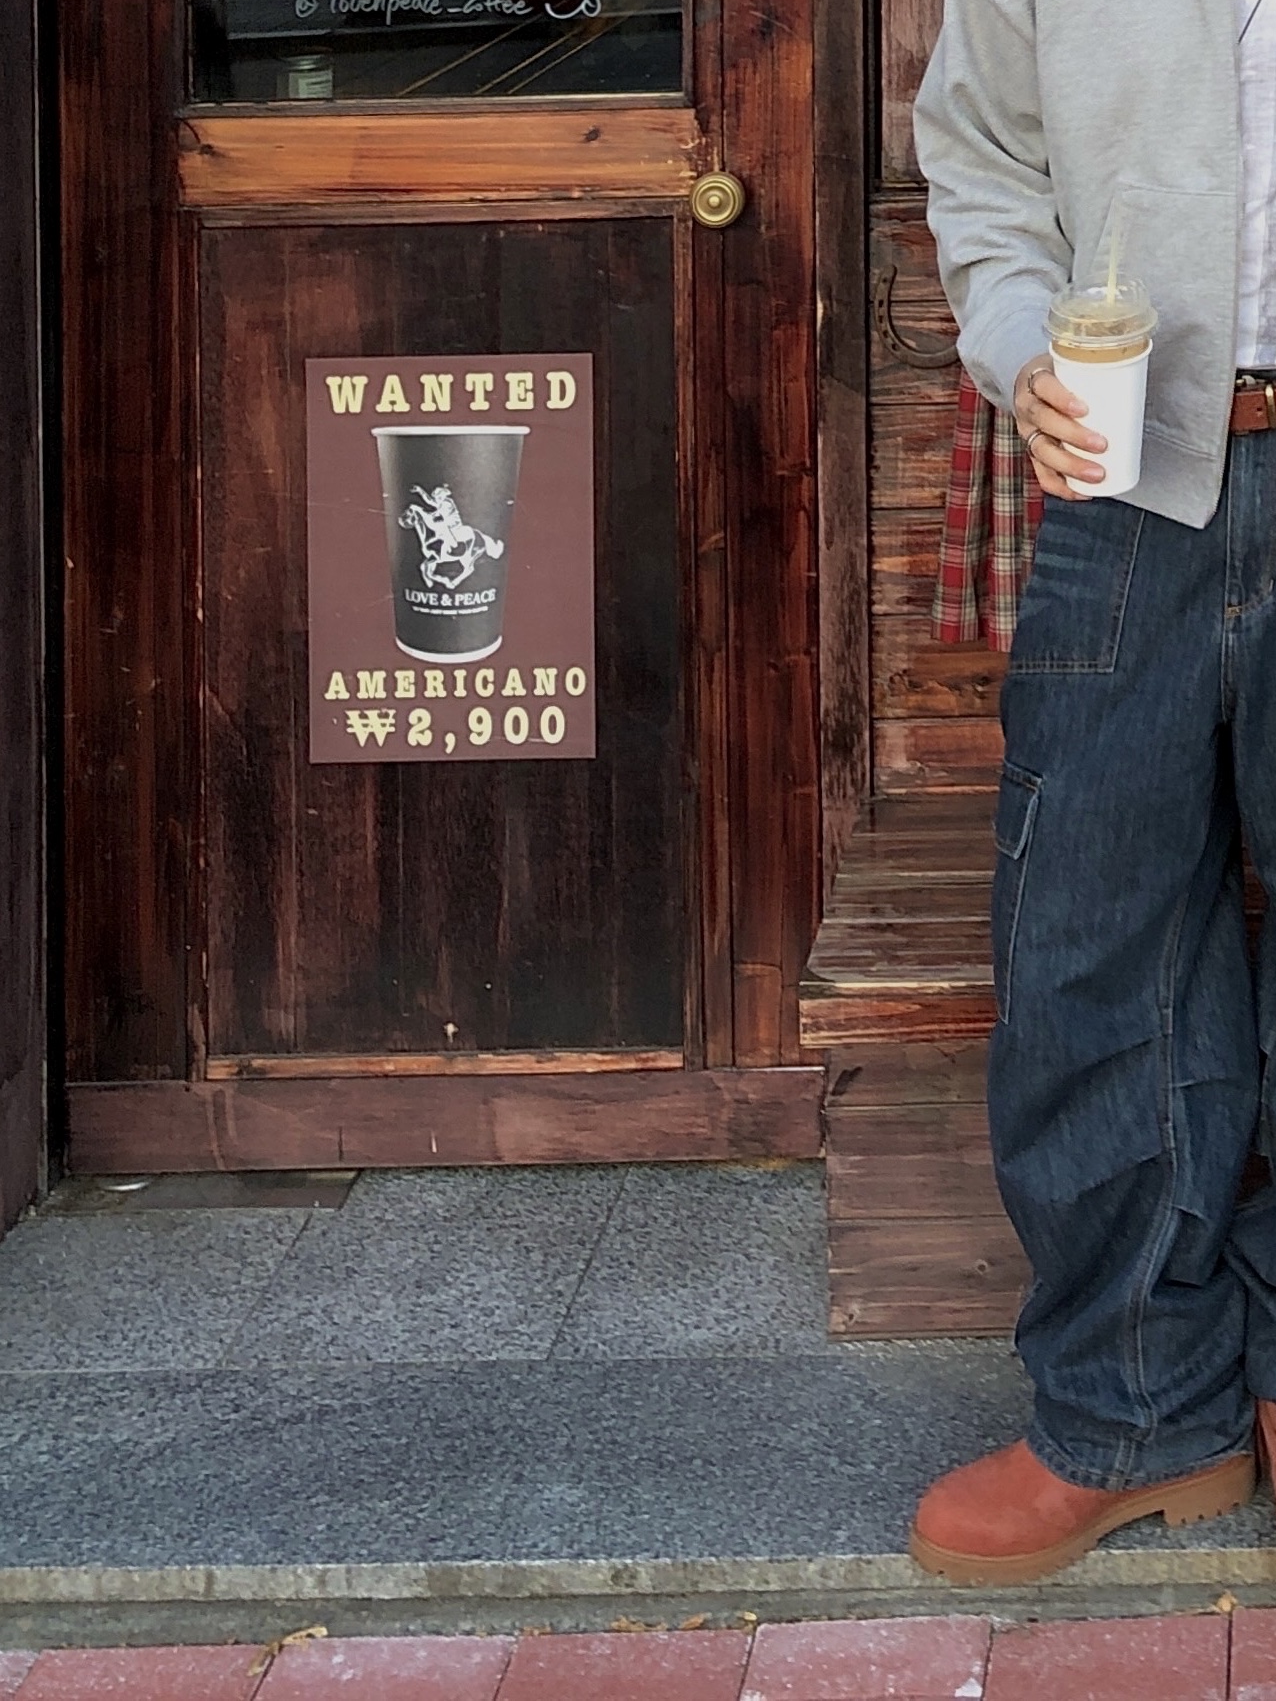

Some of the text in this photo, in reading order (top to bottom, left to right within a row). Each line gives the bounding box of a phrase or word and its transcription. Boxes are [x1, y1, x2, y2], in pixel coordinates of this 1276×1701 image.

[325, 371, 577, 414] WANTED
[405, 588, 497, 606] LOVE & PEACE
[324, 666, 587, 700] AMERICANO
[346, 706, 566, 755] ₩2,900
